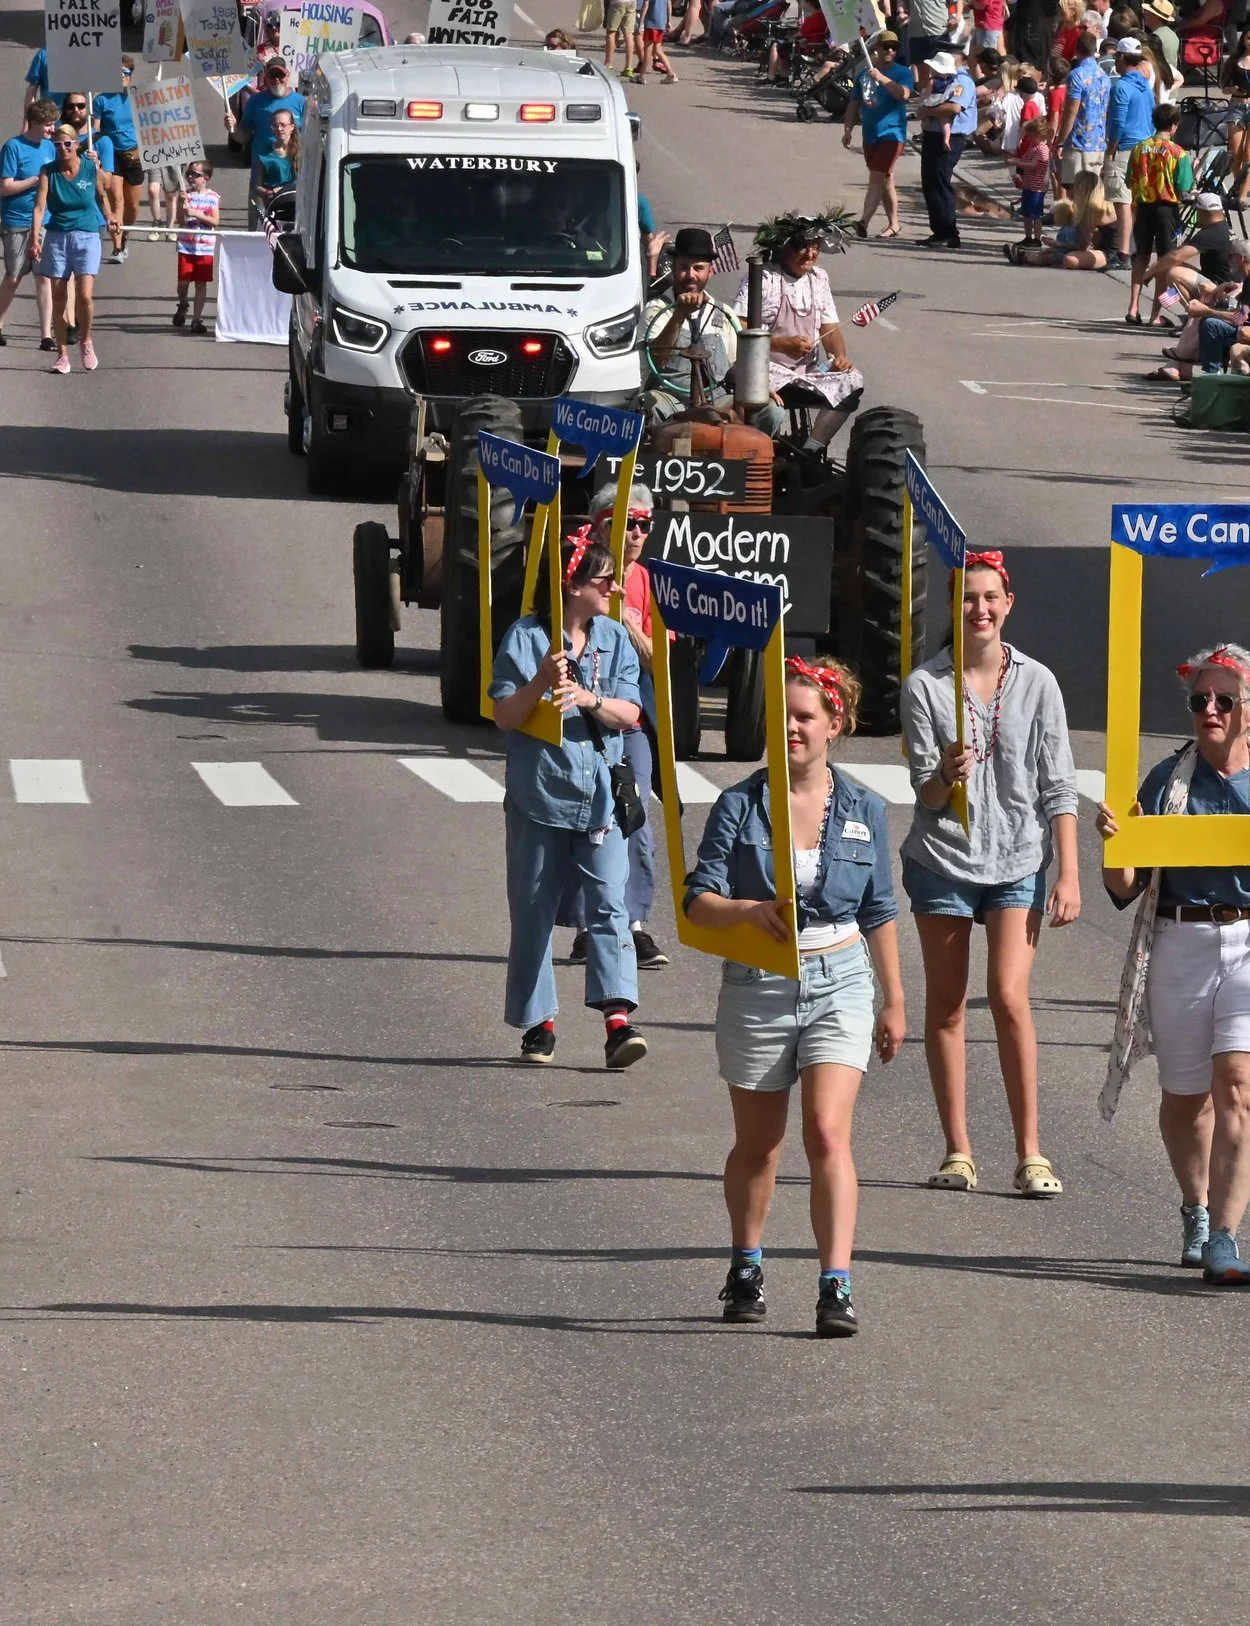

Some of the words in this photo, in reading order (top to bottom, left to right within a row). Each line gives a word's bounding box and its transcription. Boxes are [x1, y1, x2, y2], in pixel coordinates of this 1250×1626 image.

[59, 0, 100, 10] FAIR
[301, 2, 354, 26] HOUSING
[47, 13, 118, 30] HOUSING
[200, 18, 236, 35] Today
[447, 7, 499, 30] FAIR
[68, 31, 104, 48] ACT
[133, 83, 191, 109] HEALTHY
[138, 105, 192, 127] HOMES
[140, 123, 197, 146] HEALTHY
[143, 140, 201, 164] COMMUNITIES
[406, 157, 558, 174] WATERBURY
[557, 403, 574, 426] We
[576, 409, 600, 433] Can
[601, 414, 617, 436] Do
[620, 418, 635, 440] It!
[480, 440, 499, 467] We
[500, 448, 522, 476] Can
[523, 454, 540, 481] Do
[543, 461, 555, 487] It!
[606, 456, 645, 477] Te
[651, 458, 736, 497] 1952
[907, 461, 920, 501] We
[921, 484, 937, 527] Can
[937, 509, 950, 544] Do
[951, 528, 961, 561] It!
[662, 515, 790, 564] Modern
[1122, 513, 1177, 544] We
[1186, 513, 1250, 544] Can
[653, 573, 680, 609] We
[686, 582, 719, 618] Can
[723, 590, 747, 623] Do
